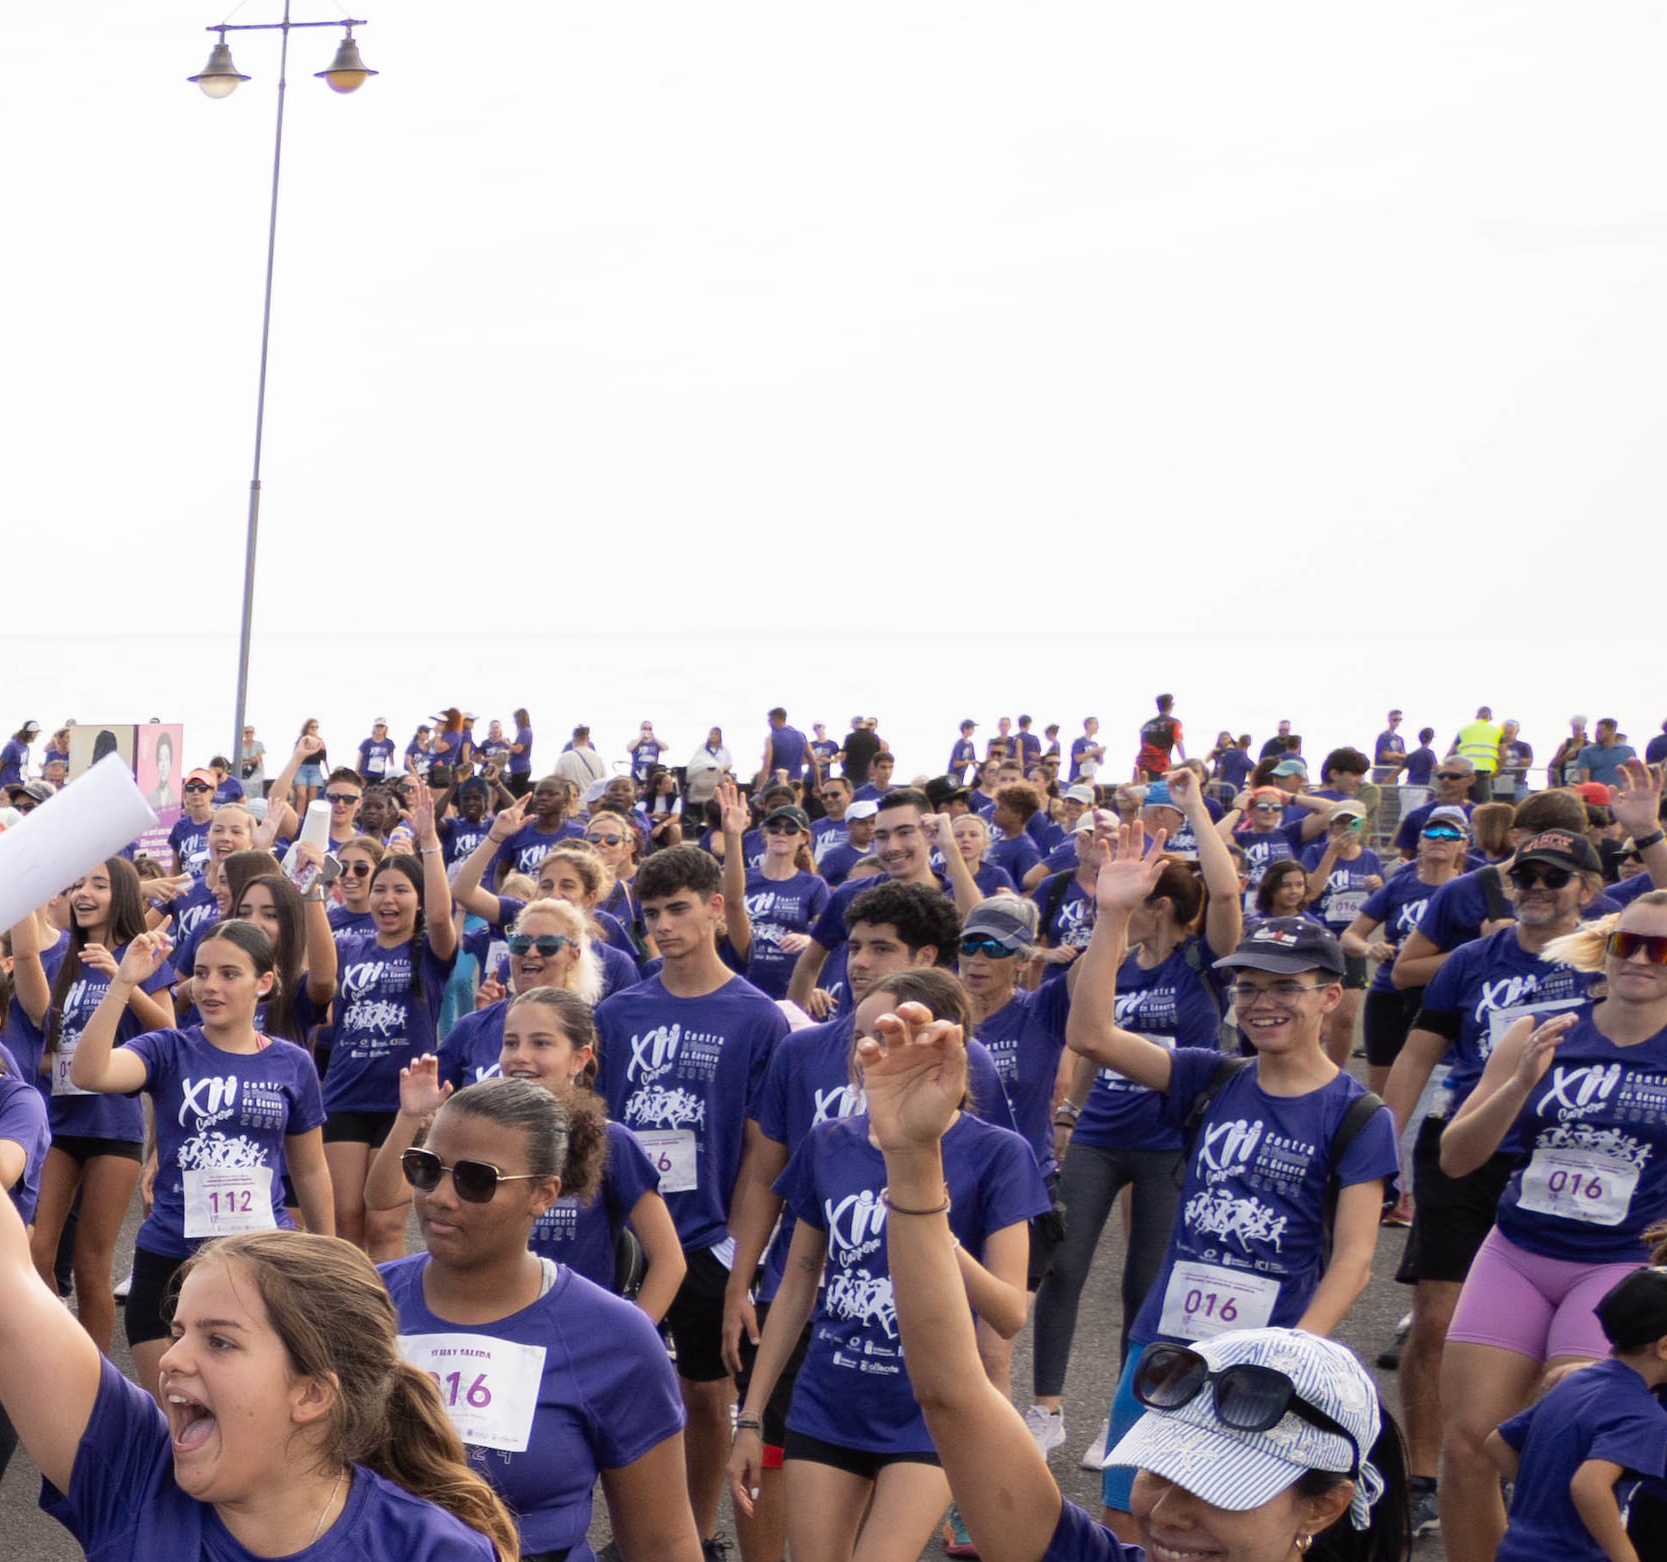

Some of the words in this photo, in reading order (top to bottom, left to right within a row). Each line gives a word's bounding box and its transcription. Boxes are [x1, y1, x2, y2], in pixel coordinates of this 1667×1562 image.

[684, 1030, 724, 1046] Contra
[1265, 1132, 1314, 1155] Contra
[1548, 1171, 1603, 1199] 016
[209, 1191, 252, 1213] 112
[1184, 1289, 1237, 1322] 016
[439, 1348, 456, 1356] HAY
[460, 1349, 491, 1359] SALIDA
